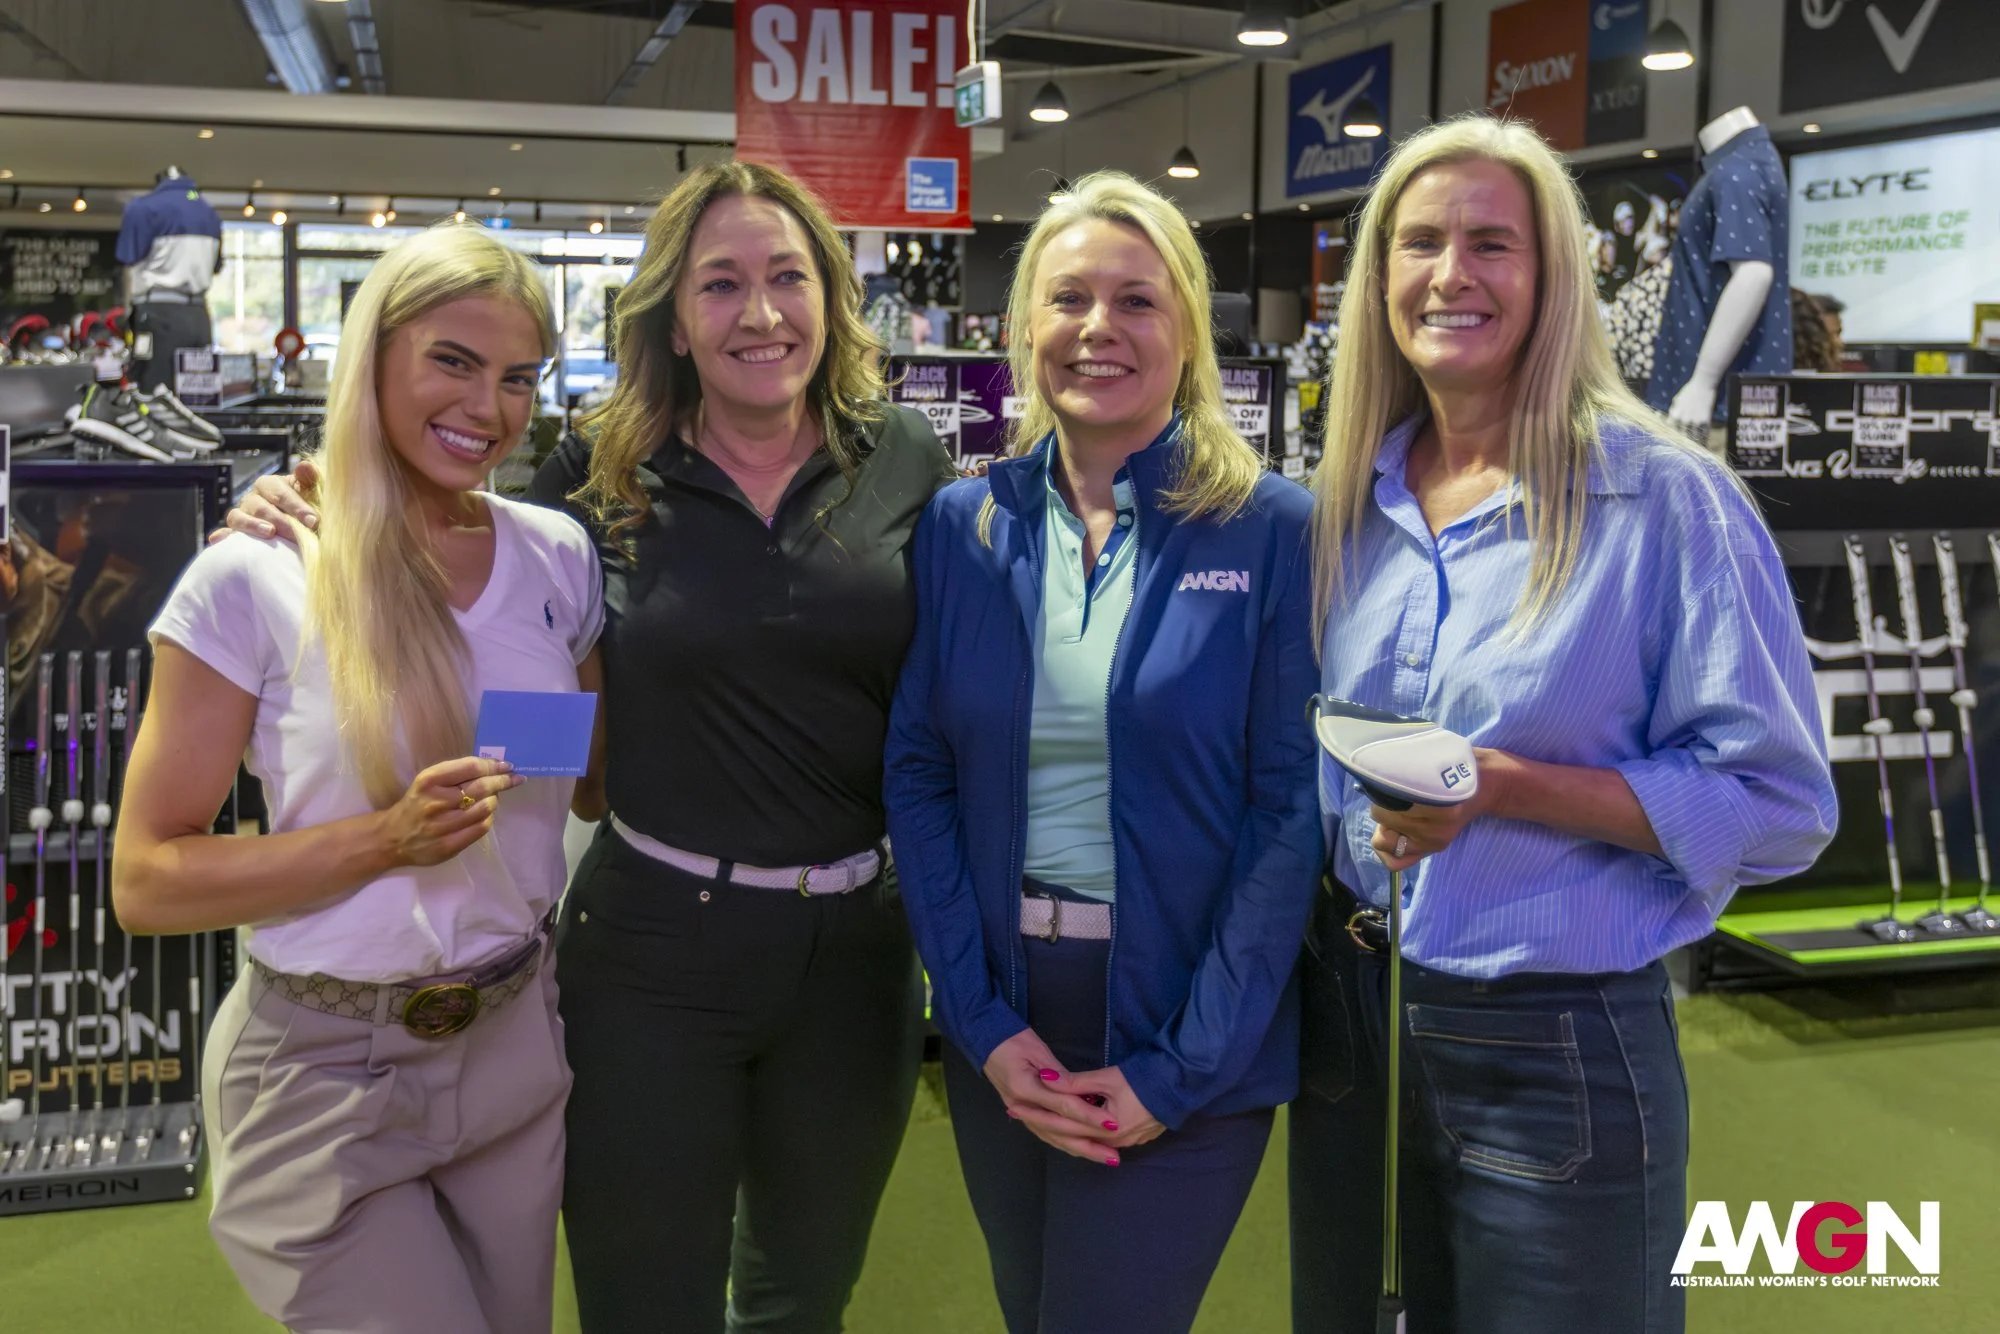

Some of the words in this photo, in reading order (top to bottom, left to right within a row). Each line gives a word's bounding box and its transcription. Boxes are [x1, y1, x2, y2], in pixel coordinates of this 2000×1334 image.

[751, 3, 956, 108] SALE!
[1800, 167, 1931, 202] ELYTE
[1803, 220, 1841, 238] THE
[1846, 213, 1932, 235] FUTURE
[1937, 208, 1970, 230] OF
[1801, 231, 1966, 259] PERFORMANCE
[1824, 257, 1887, 277] ELYTE
[902, 366, 948, 382] BLACK
[902, 383, 948, 399] FRIDAY
[928, 407, 953, 417] OFF
[1240, 408, 1264, 418] OFF
[1178, 570, 1249, 593] AWGN
[0, 1009, 181, 1064] RON
[7, 1057, 182, 1093] PUTTERS
